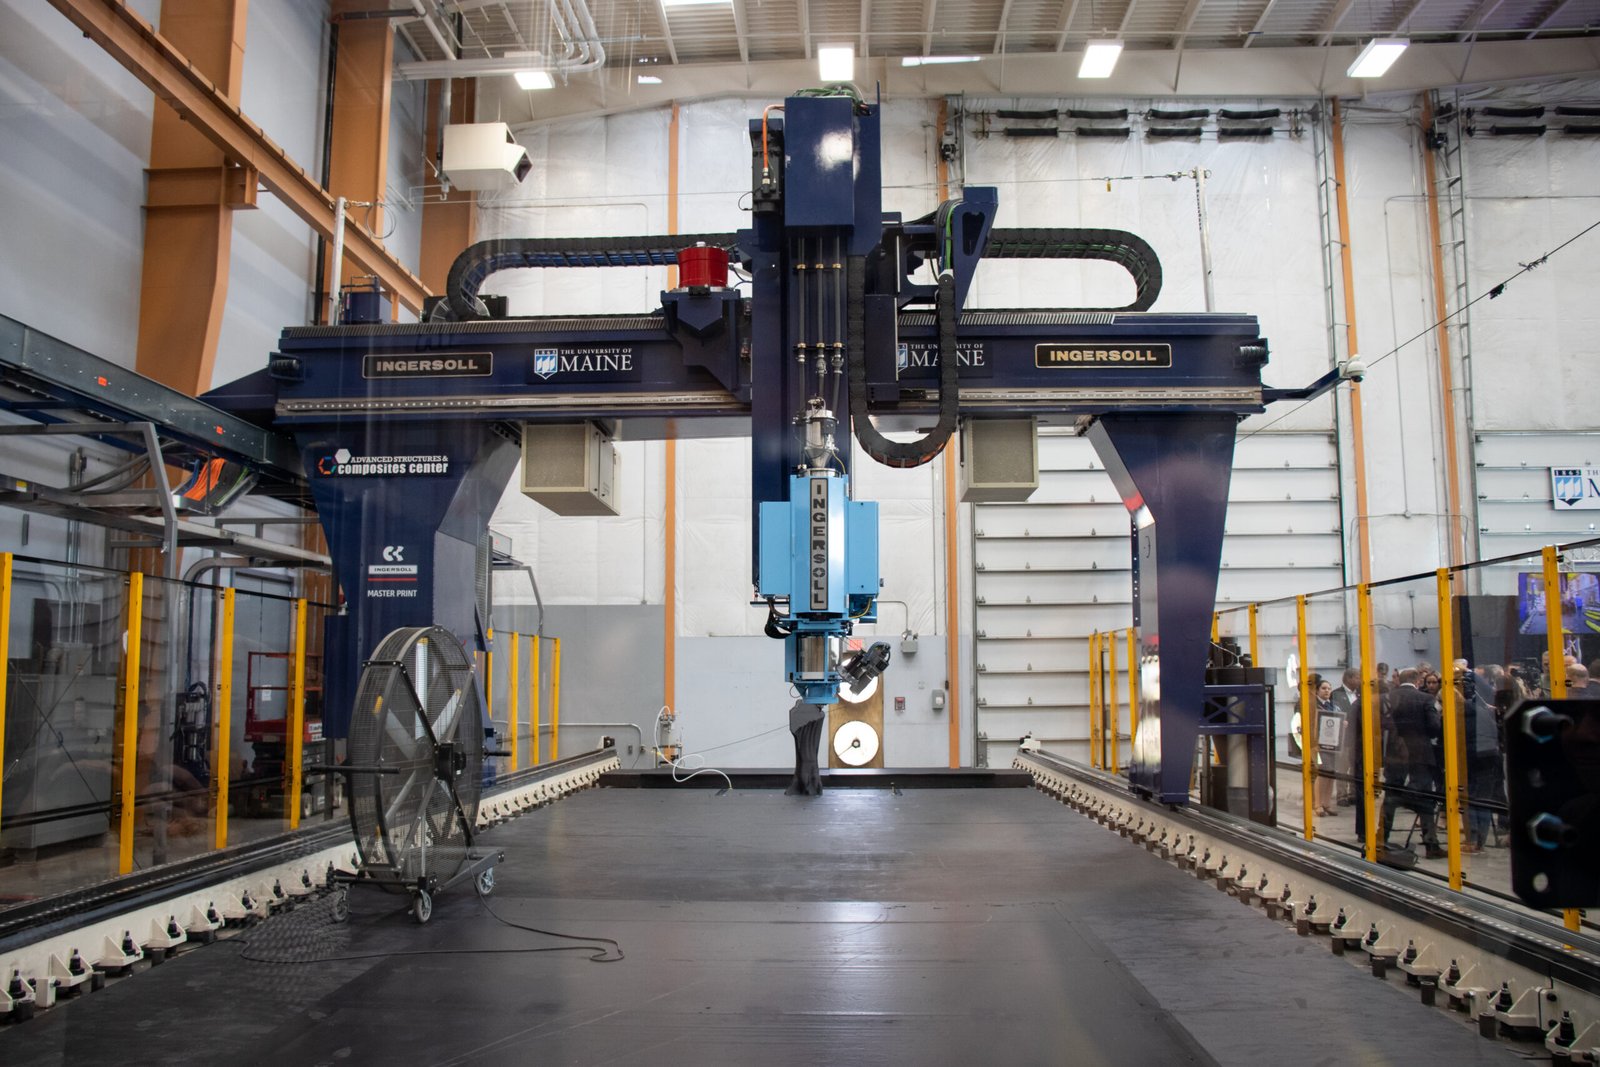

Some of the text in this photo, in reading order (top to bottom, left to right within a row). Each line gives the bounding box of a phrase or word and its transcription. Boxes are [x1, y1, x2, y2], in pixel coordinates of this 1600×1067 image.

[910, 349, 985, 367] MNE
[1050, 350, 1157, 362] INGERSOLL
[376, 359, 478, 372] INGERSOLL
[560, 354, 633, 372] MAINE
[393, 455, 442, 463] STRUCTURES
[337, 462, 449, 475] composites center
[812, 484, 826, 604] INGERSOLL
[367, 589, 418, 597] MASTER PRINT
